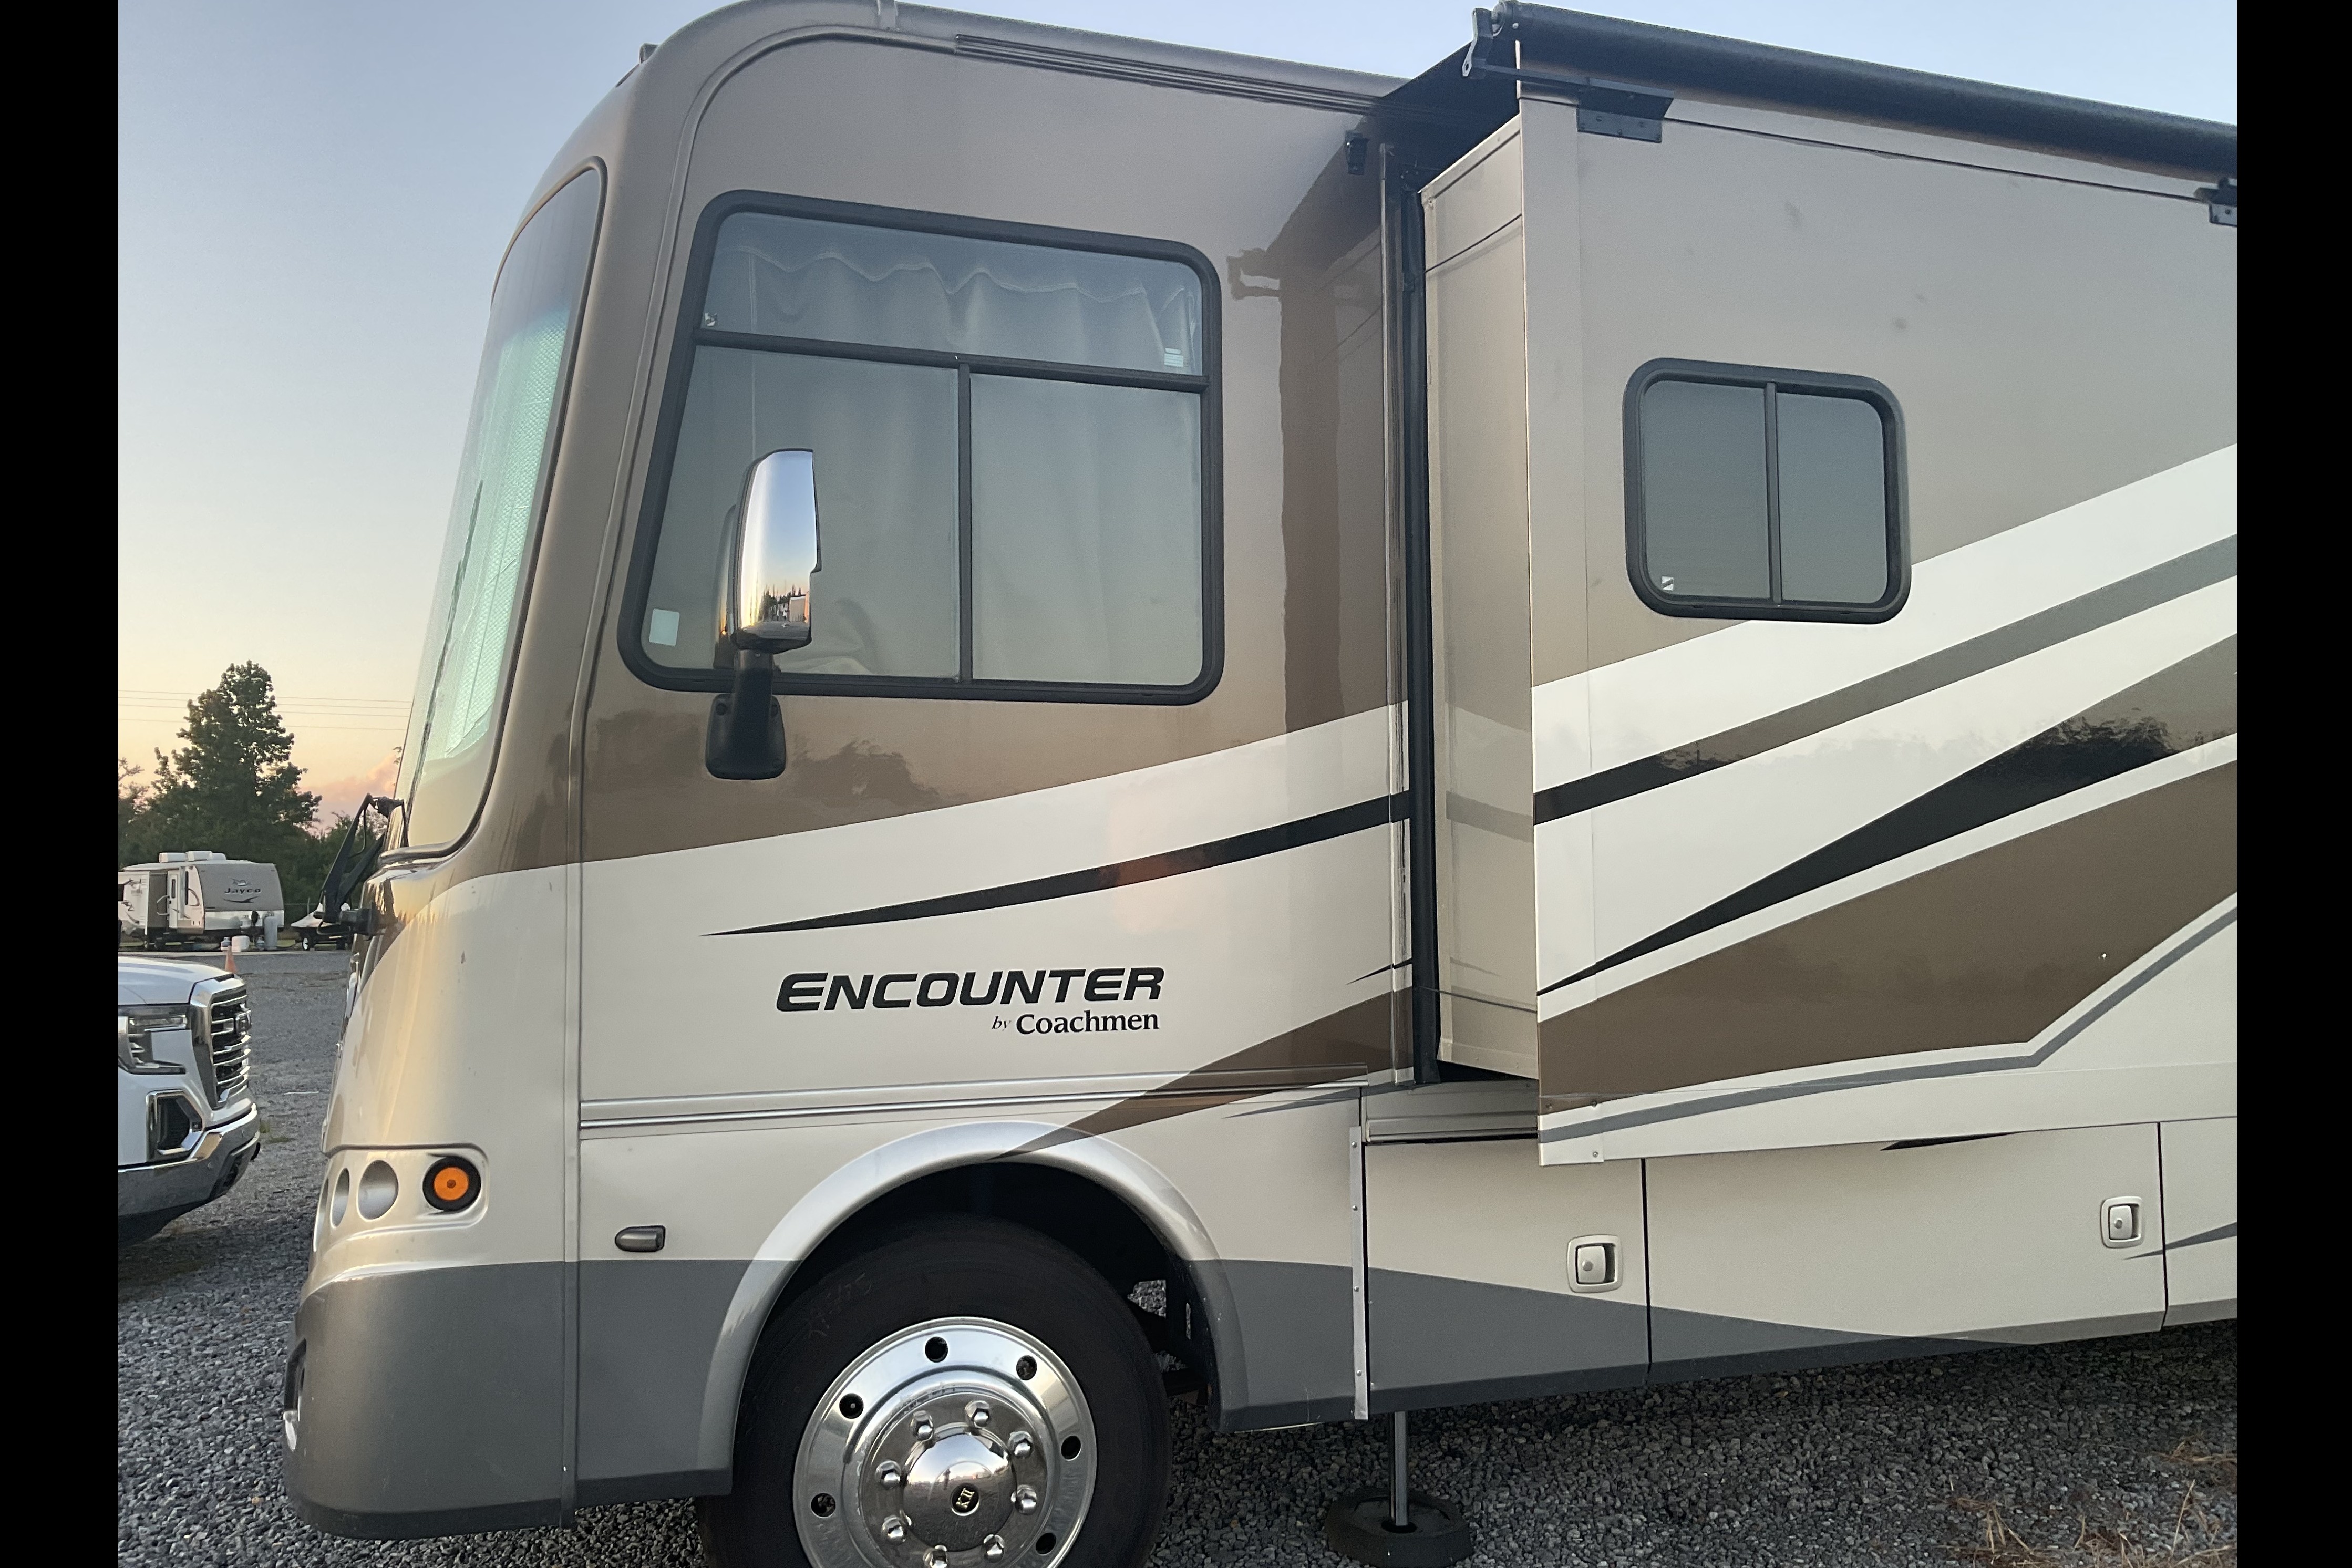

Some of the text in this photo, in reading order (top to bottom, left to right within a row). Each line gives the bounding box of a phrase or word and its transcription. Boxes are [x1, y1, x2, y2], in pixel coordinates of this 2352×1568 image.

[776, 967, 1164, 1012] ENCOUNTER
[992, 1010, 1160, 1035] by Coachmen
